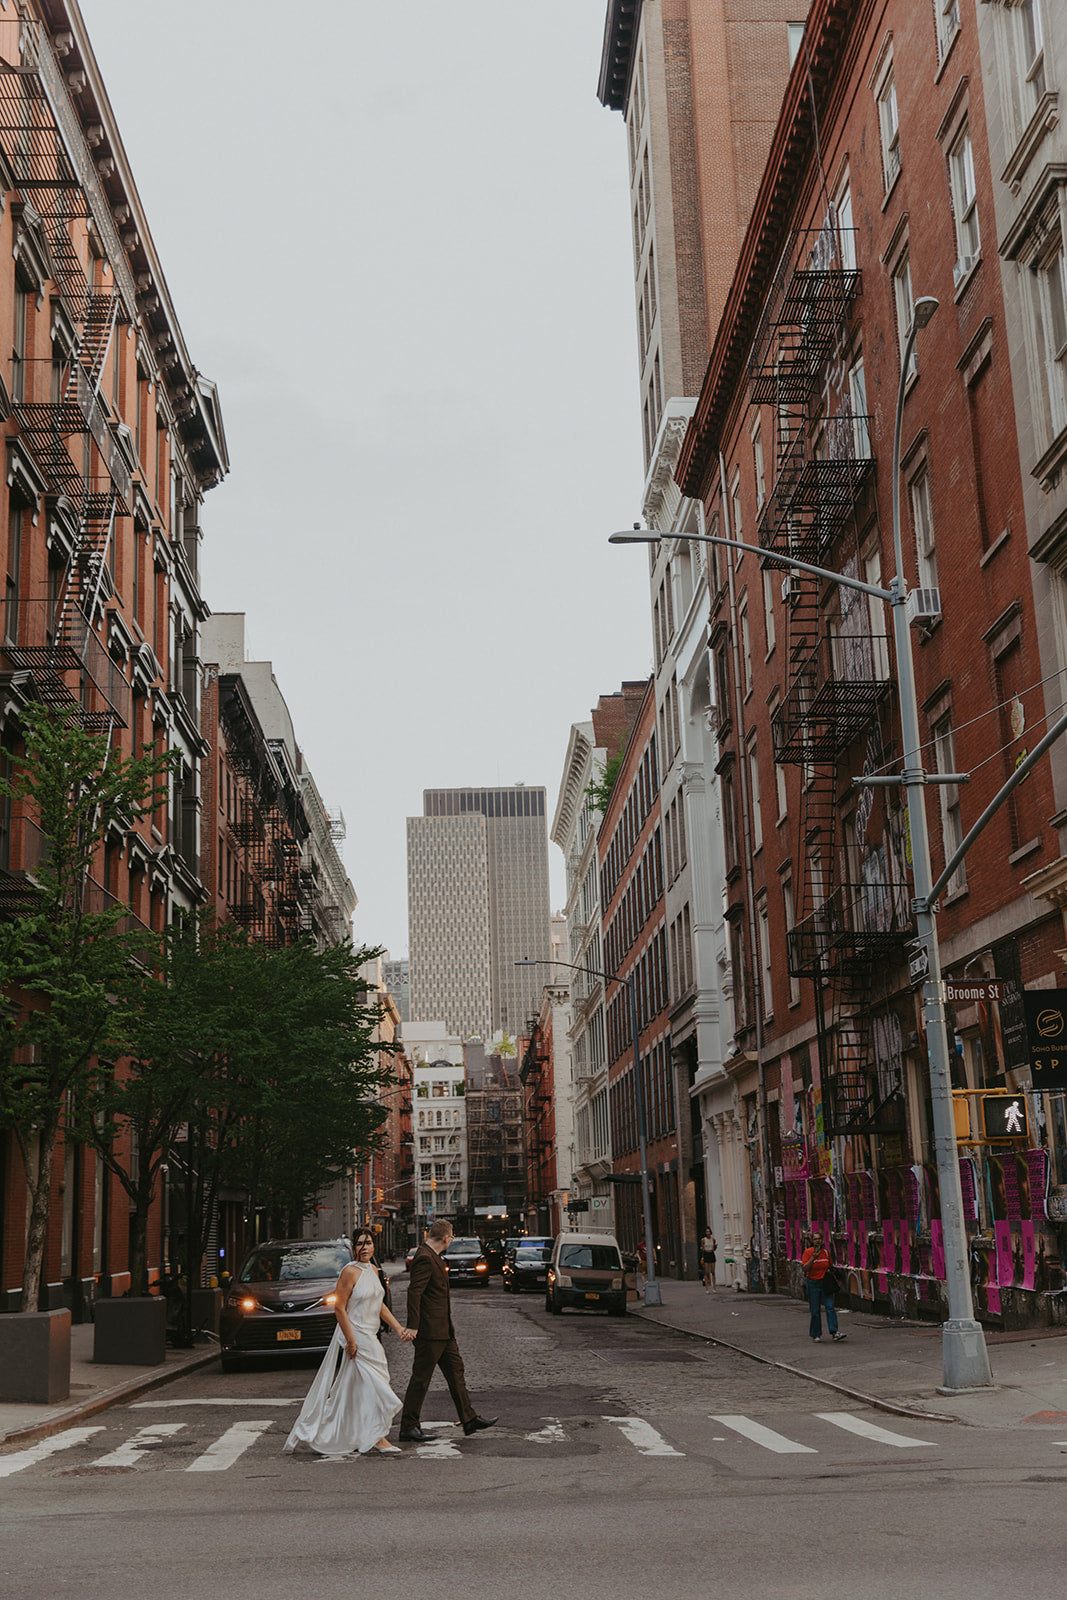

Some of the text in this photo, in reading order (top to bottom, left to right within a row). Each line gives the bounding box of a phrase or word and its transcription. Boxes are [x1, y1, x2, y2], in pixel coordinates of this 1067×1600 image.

[947, 986, 985, 1000] Broome
[988, 984, 999, 999] St
[593, 1199, 607, 1208] DV
